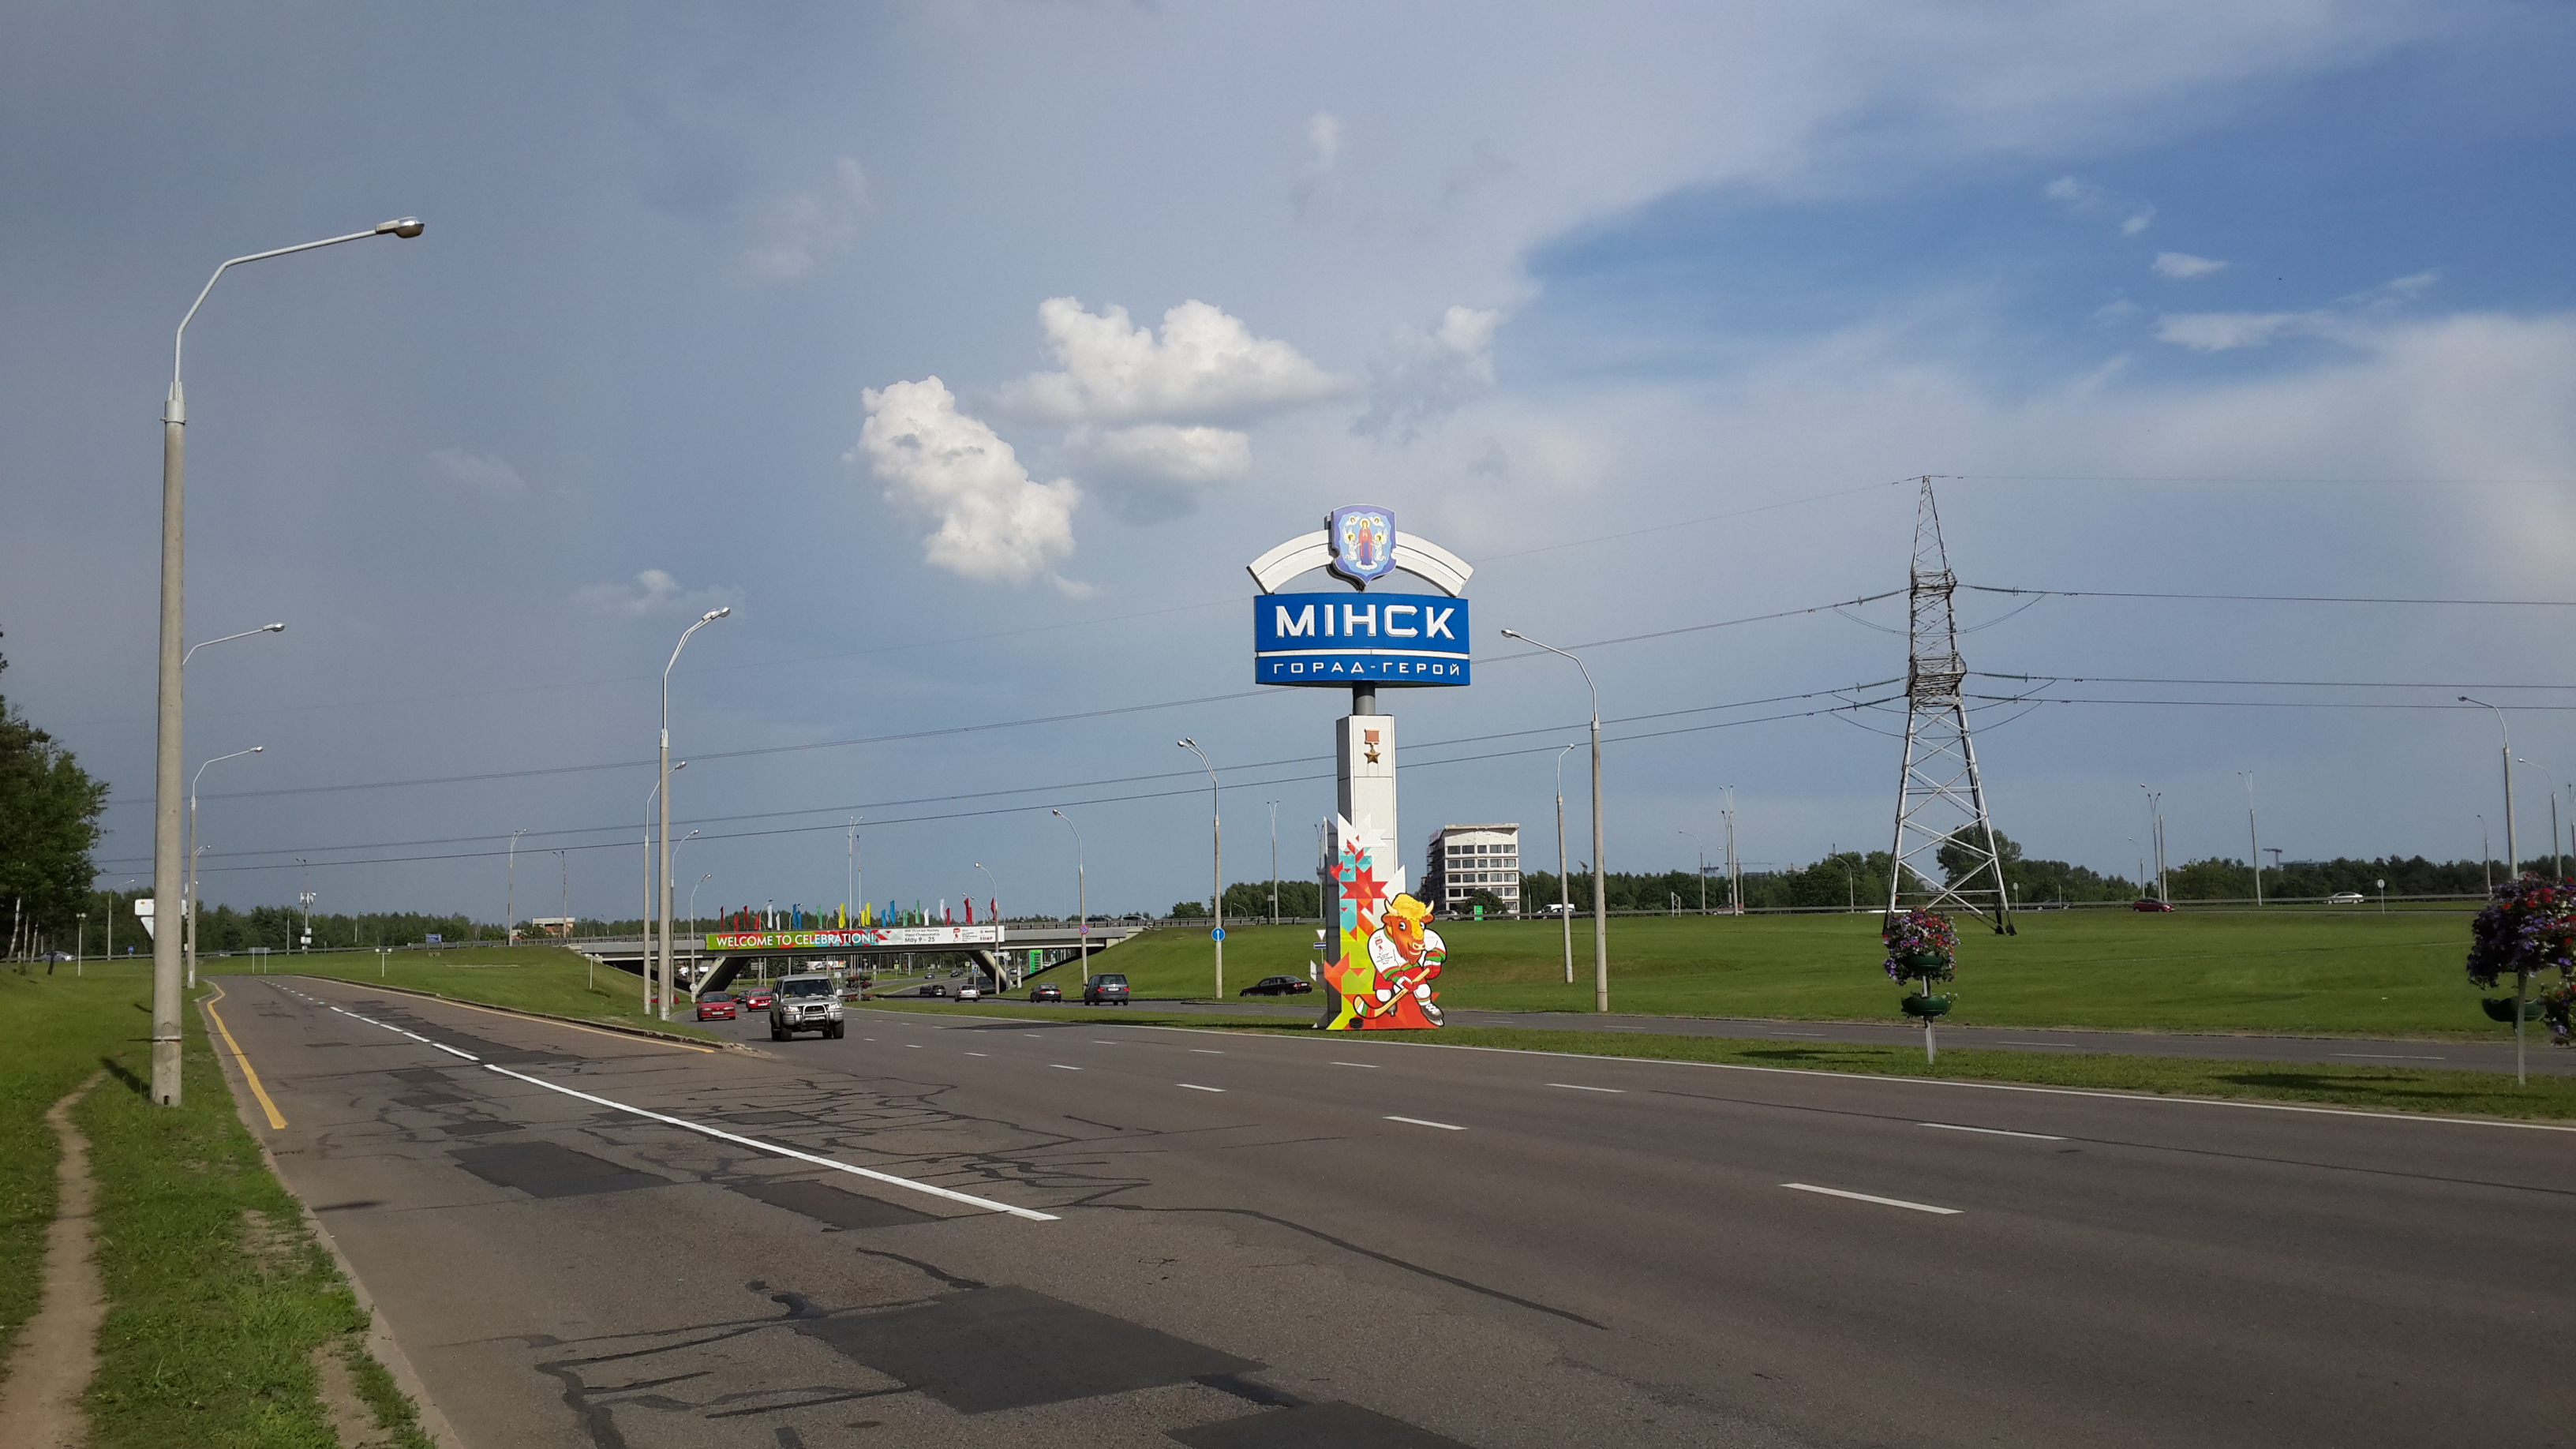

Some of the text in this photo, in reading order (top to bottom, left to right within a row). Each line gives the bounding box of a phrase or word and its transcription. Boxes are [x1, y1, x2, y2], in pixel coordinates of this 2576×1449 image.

[1275, 604, 1455, 639] МІНСК
[1274, 662, 1459, 676] ГОРАД-ГЕРОЙ
[717, 933, 874, 947] WELCOME TO CELEBRATION!
